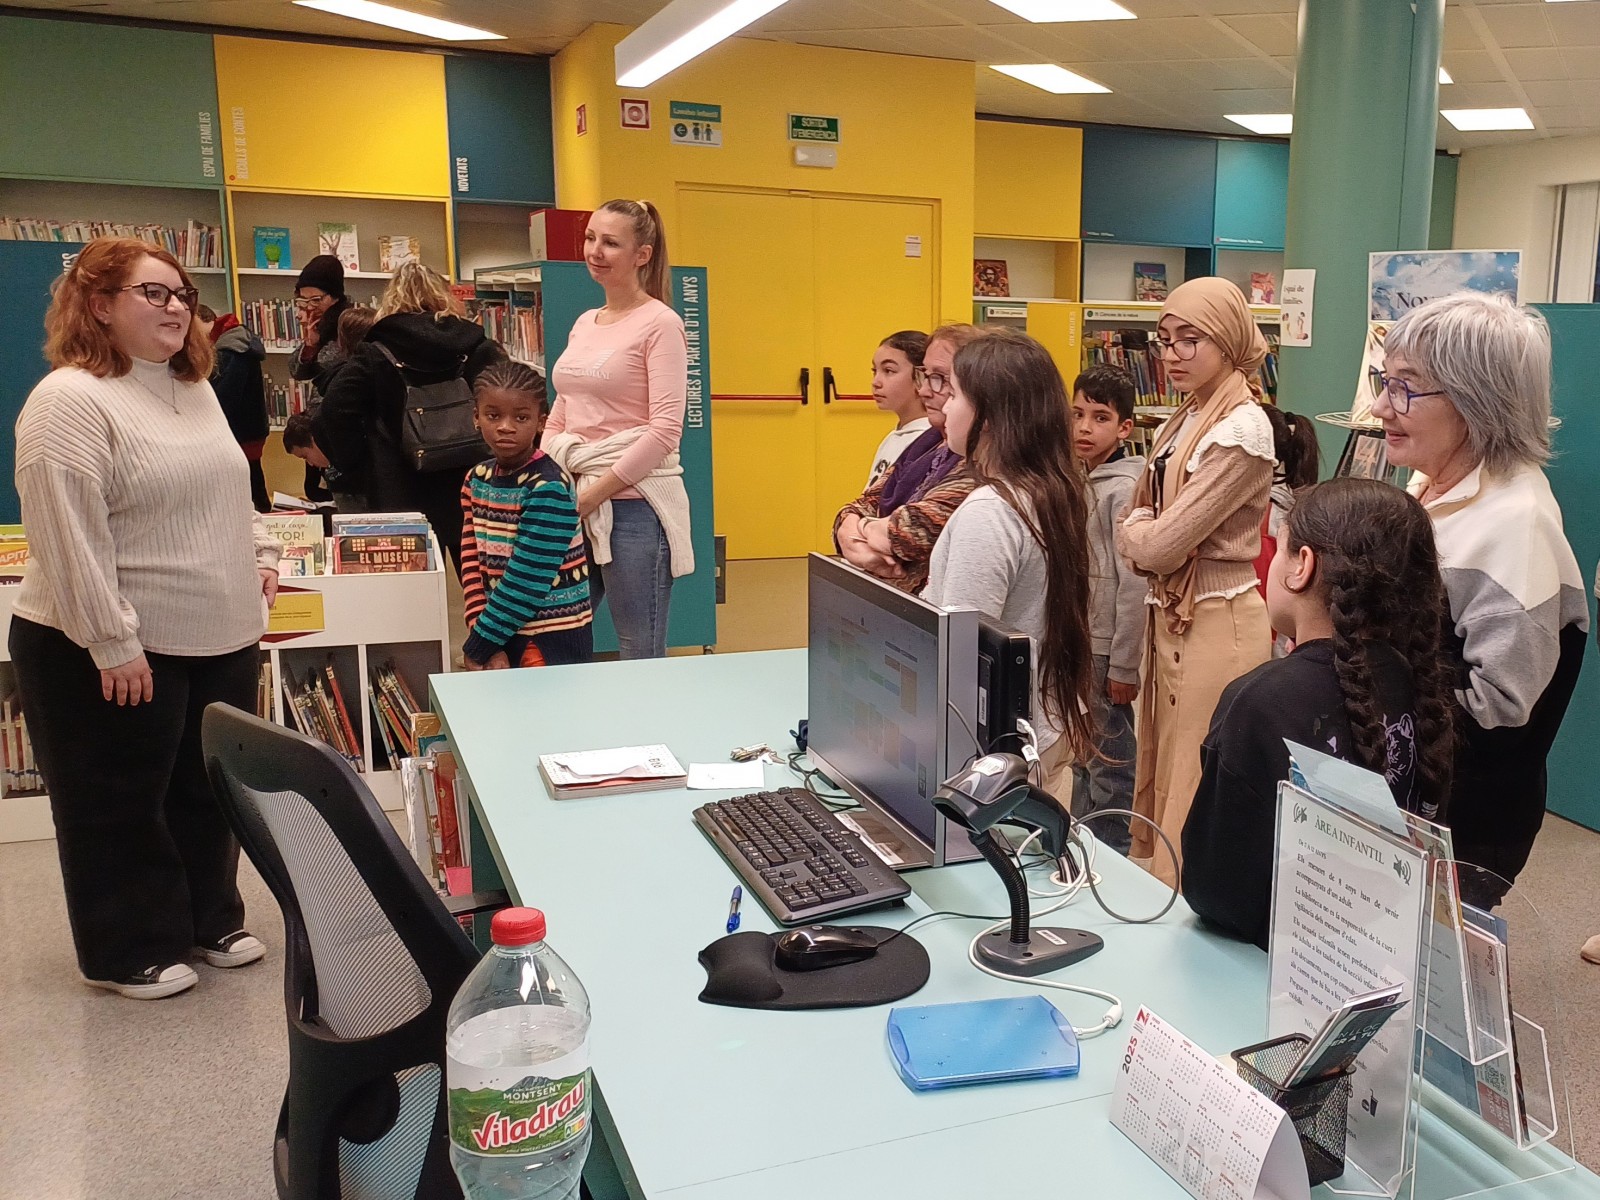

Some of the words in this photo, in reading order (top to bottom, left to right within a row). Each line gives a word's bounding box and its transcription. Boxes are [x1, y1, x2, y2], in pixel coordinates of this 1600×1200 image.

[201, 145, 214, 156] DE
[234, 136, 247, 146] DE
[202, 157, 216, 178] ESPAI
[456, 157, 469, 192] NOVETATS
[682, 276, 699, 303] ANYS
[683, 307, 700, 327] D'11
[685, 330, 701, 366] PARTIR
[687, 368, 702, 376] A
[687, 378, 703, 428] LECTURES
[360, 551, 372, 564] EL
[373, 551, 409, 564] MUSEU
[1314, 815, 1338, 840] ÀREA
[1339, 830, 1385, 865] INFANTIL
[1296, 868, 1325, 894] acompanyats
[1326, 885, 1338, 900] d'un
[1338, 893, 1353, 909] adult.
[1308, 860, 1324, 876] menors
[1328, 871, 1334, 882] de
[1345, 882, 1356, 897] anys
[1360, 890, 1370, 903] han
[1374, 898, 1380, 909] de
[1384, 904, 1399, 920] venir
[1295, 885, 1300, 895] La
[1301, 889, 1322, 909] biblioteca
[1323, 904, 1328, 912] no
[1340, 914, 1367, 939] responsable
[1368, 931, 1374, 942] de
[1375, 935, 1380, 946] la
[1381, 941, 1392, 953] cura
[1314, 912, 1323, 925] dels
[1322, 949, 1335, 965] taules
[1336, 959, 1342, 970] de
[1342, 964, 1347, 973] la
[1337, 946, 1350, 960] tenen
[1310, 974, 1318, 986] que
[1319, 979, 1323, 989] hi
[1310, 992, 1323, 1006] posar
[1122, 1035, 1138, 1075] 2025
[503, 1082, 563, 1101] MONTSENY
[471, 1077, 585, 1151] Viladrau
